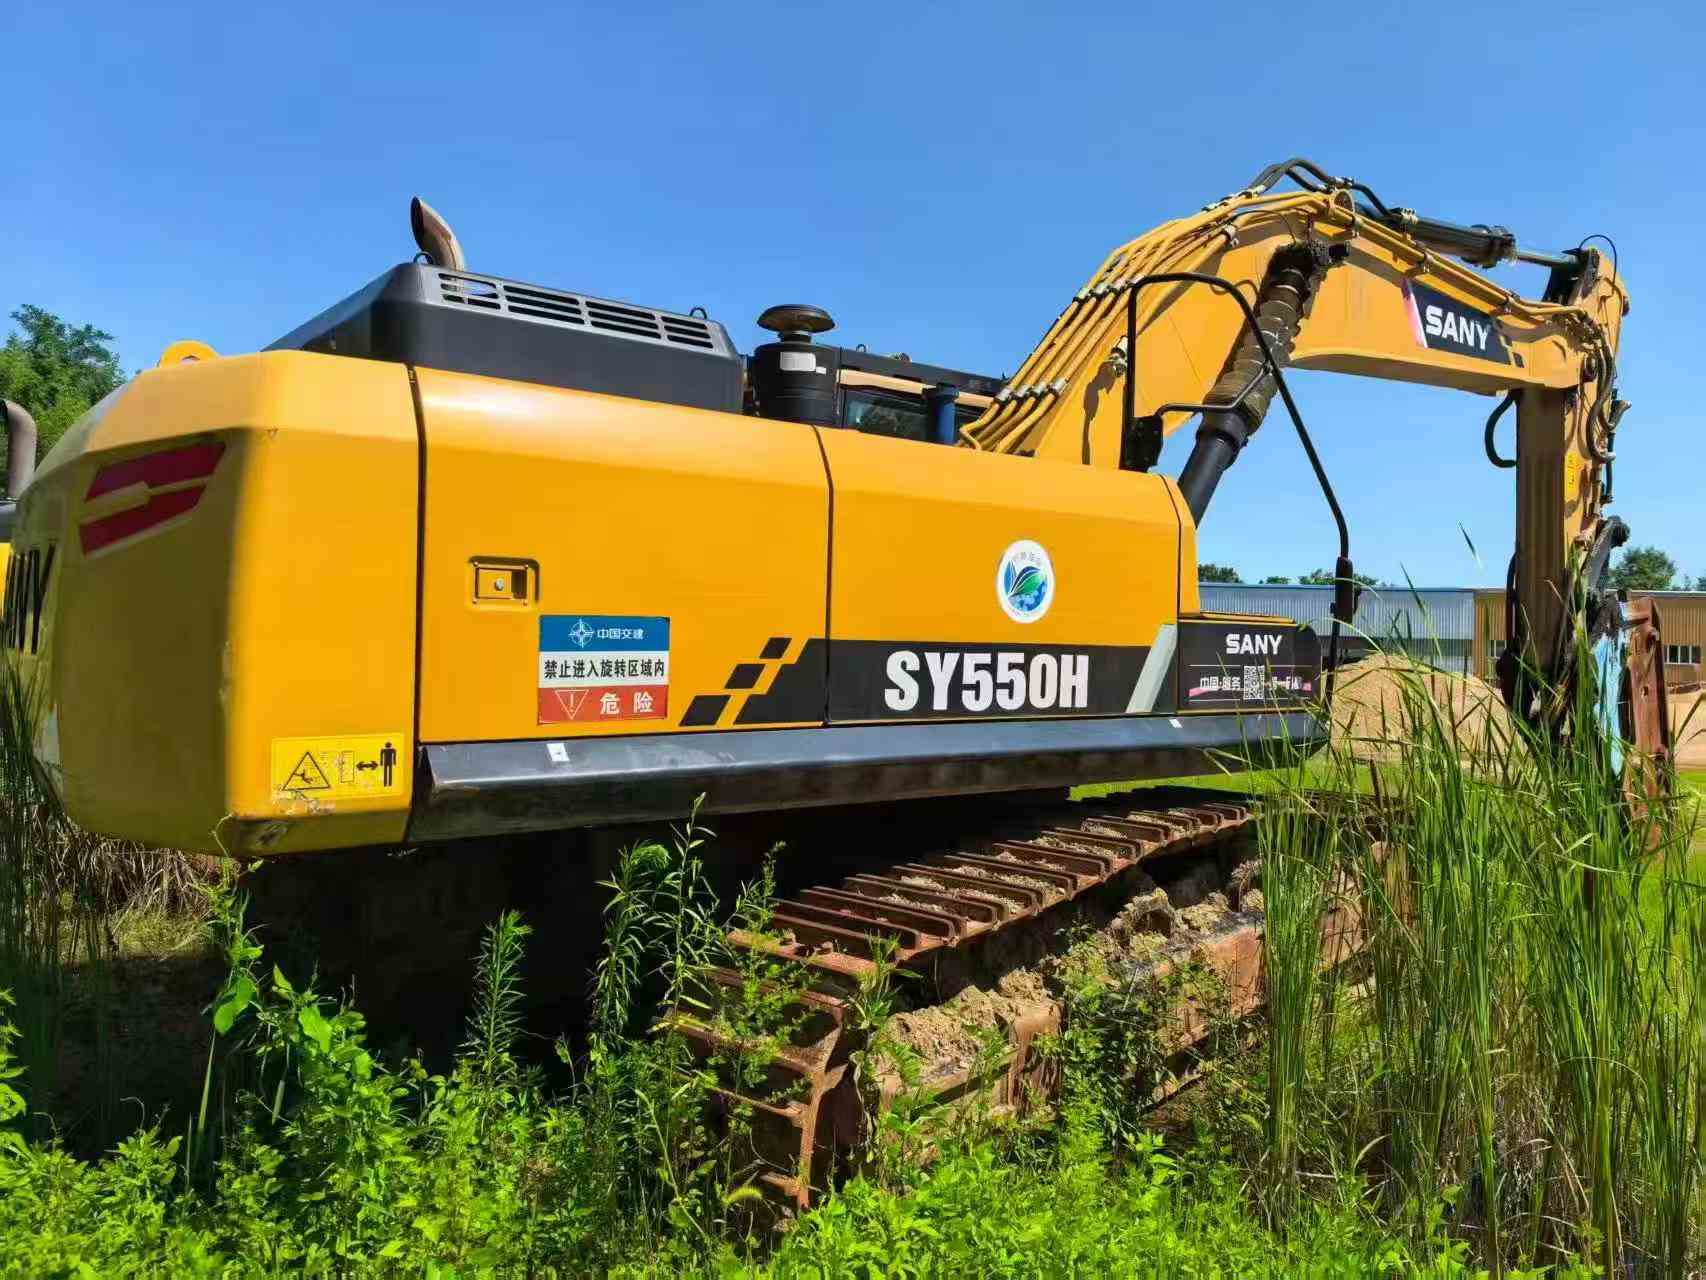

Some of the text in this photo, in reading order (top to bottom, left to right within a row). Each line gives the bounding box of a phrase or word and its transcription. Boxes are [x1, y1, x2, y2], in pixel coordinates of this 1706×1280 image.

[1425, 304, 1490, 351] SANY
[597, 627, 645, 640] 中国交建
[1225, 633, 1283, 655] SANY
[544, 658, 665, 679] 禁止进入旋转区域内
[884, 650, 1090, 712] SY550H
[599, 690, 654, 715] 危险
